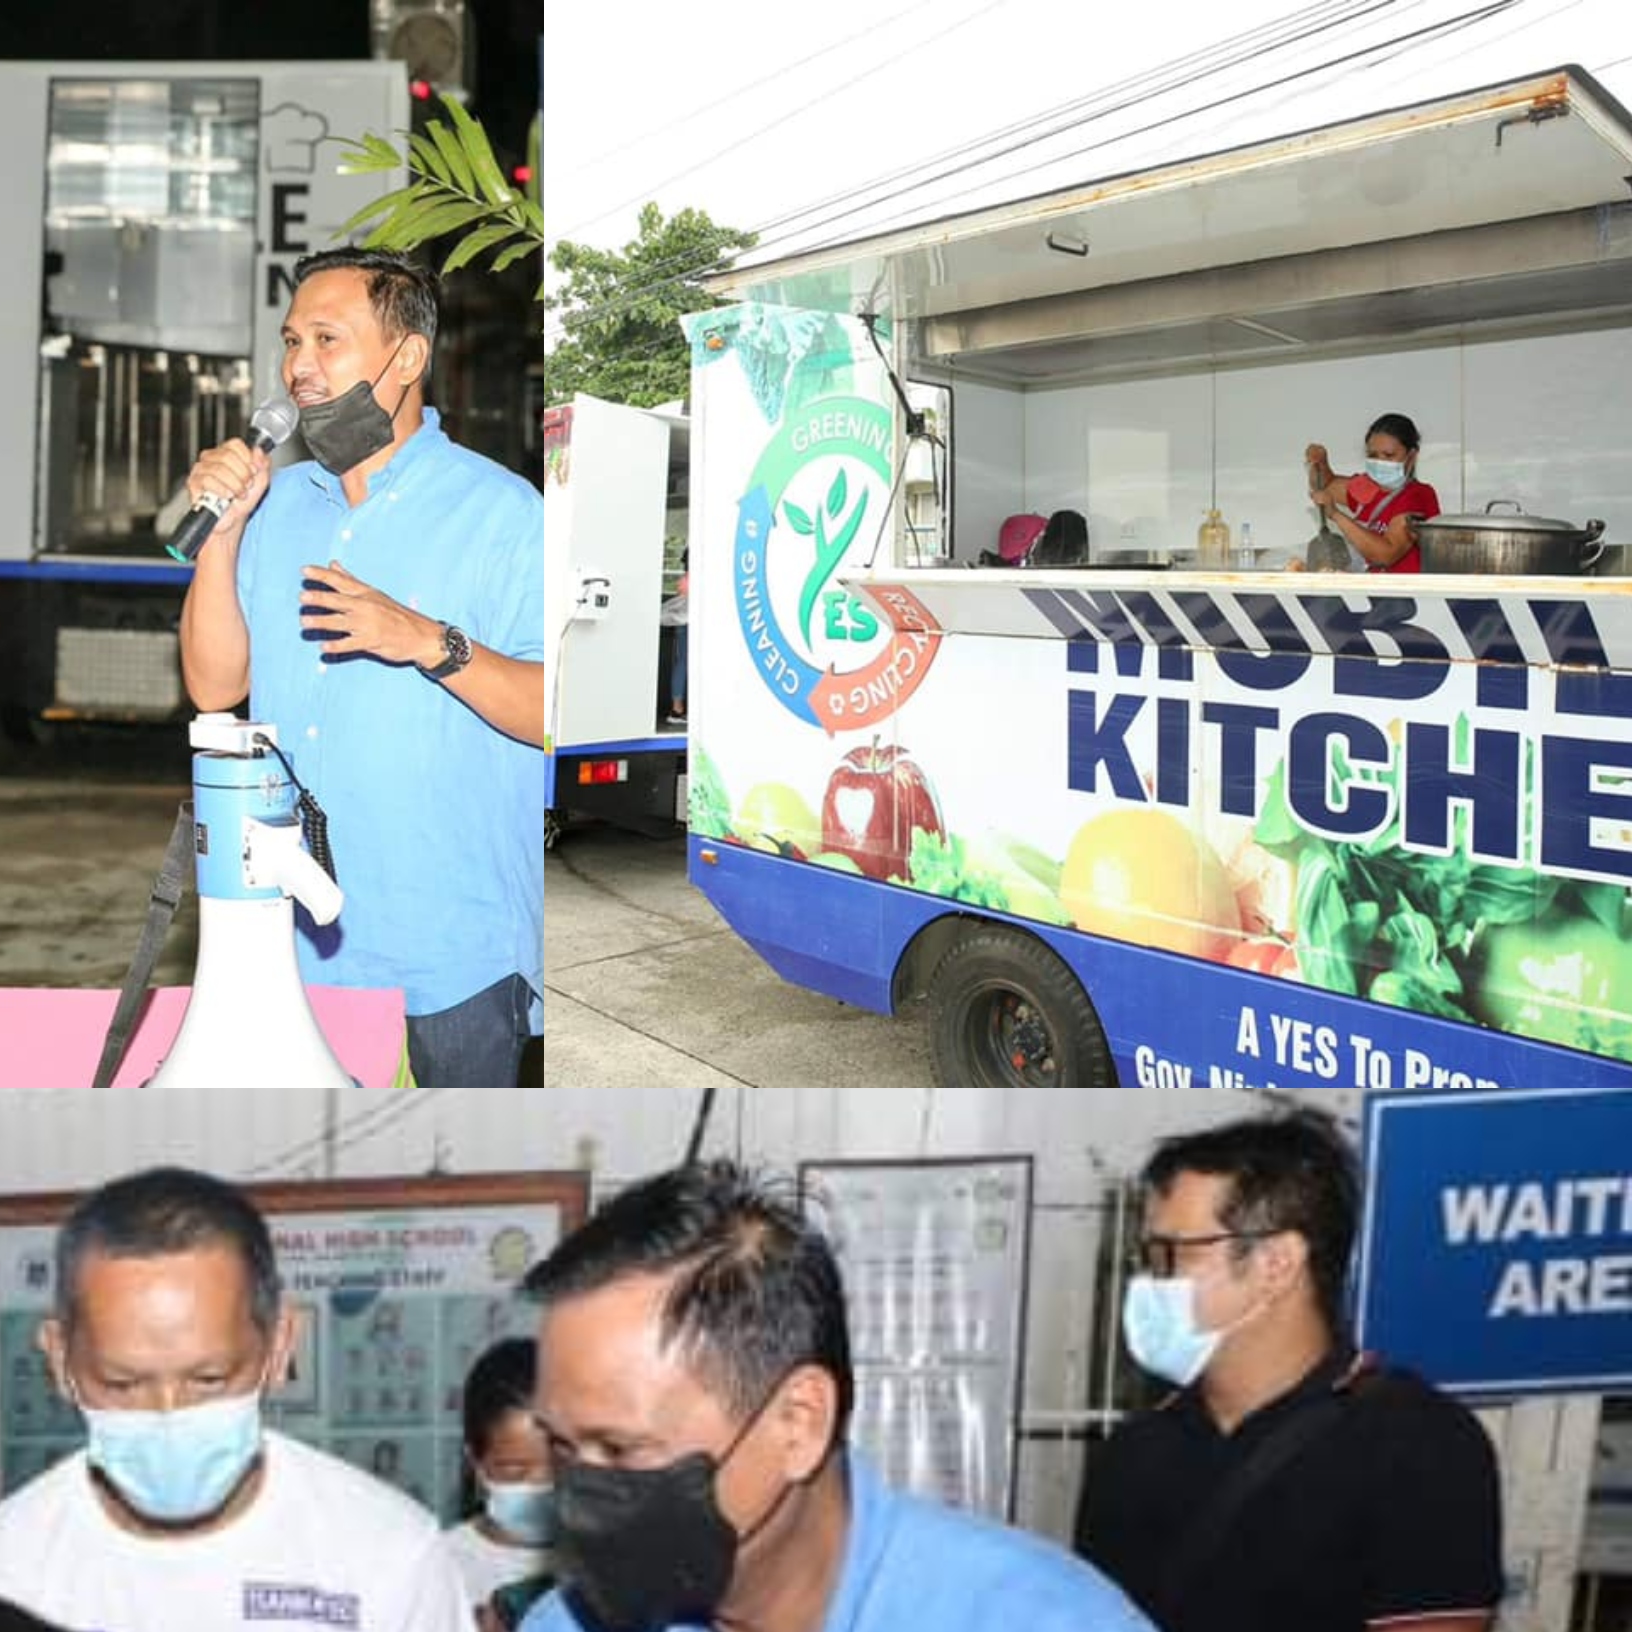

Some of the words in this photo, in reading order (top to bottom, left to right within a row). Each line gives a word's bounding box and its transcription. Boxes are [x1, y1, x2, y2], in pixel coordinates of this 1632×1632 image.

[741, 553, 800, 695] CLEANING
[850, 590, 931, 714] RECYCLING
[1236, 1006, 1261, 1058] A
[1270, 1014, 1338, 1079] YES
[1349, 1034, 1392, 1088] To
[386, 1226, 476, 1247] SCHOOL
[1487, 1255, 1632, 1318] ARE
